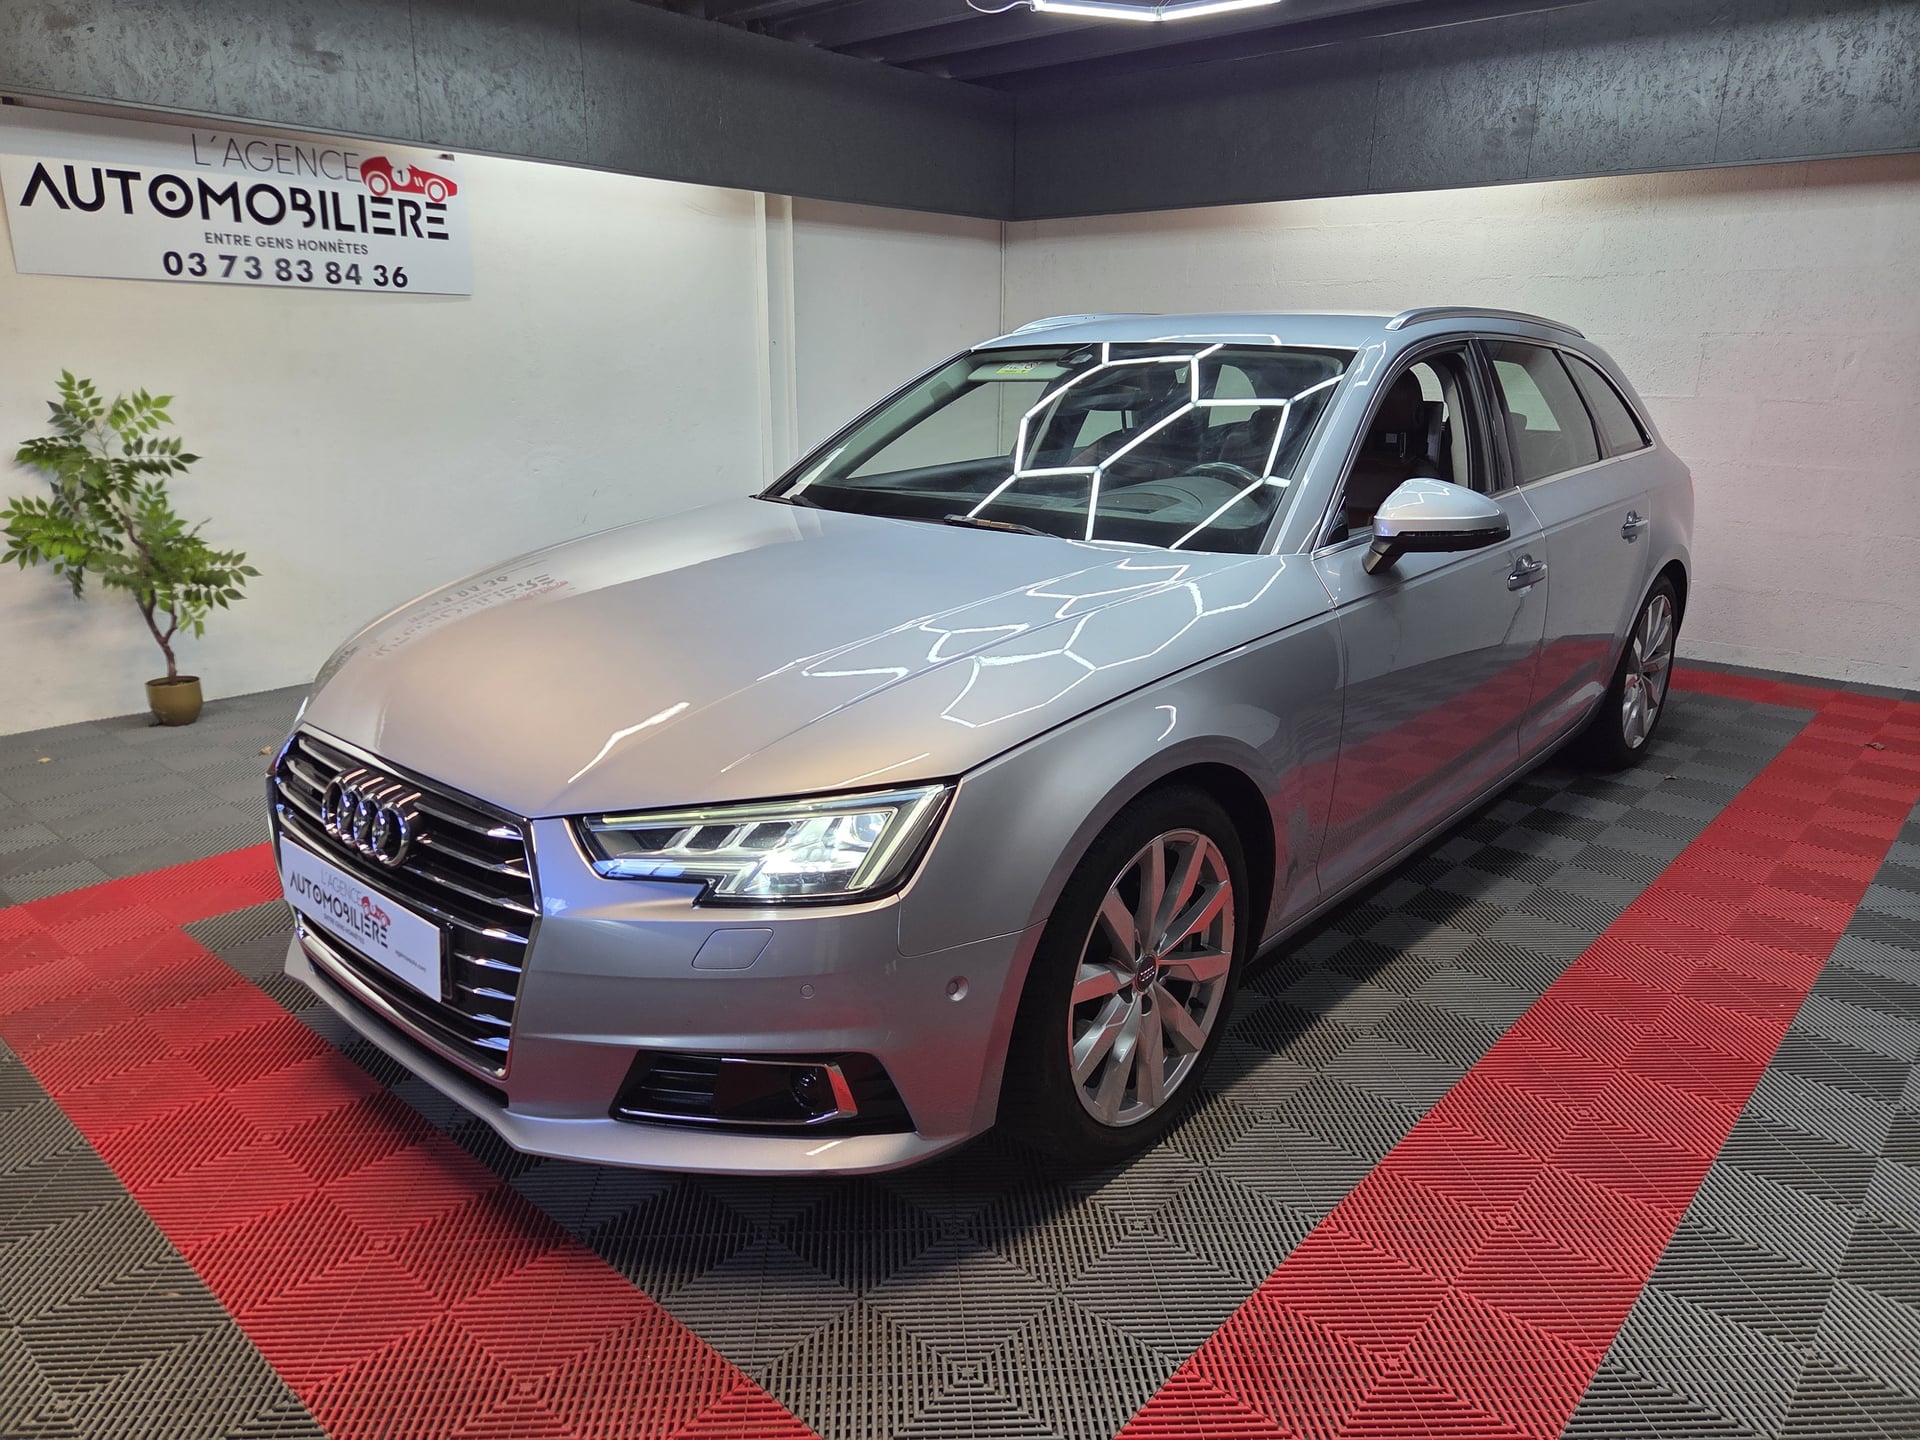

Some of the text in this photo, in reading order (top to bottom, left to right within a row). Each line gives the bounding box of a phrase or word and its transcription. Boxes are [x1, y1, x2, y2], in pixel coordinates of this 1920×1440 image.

[204, 232, 369, 255] ENTRE GENS HONNÊTES
[162, 250, 409, 288] 03 73 83 84 36
